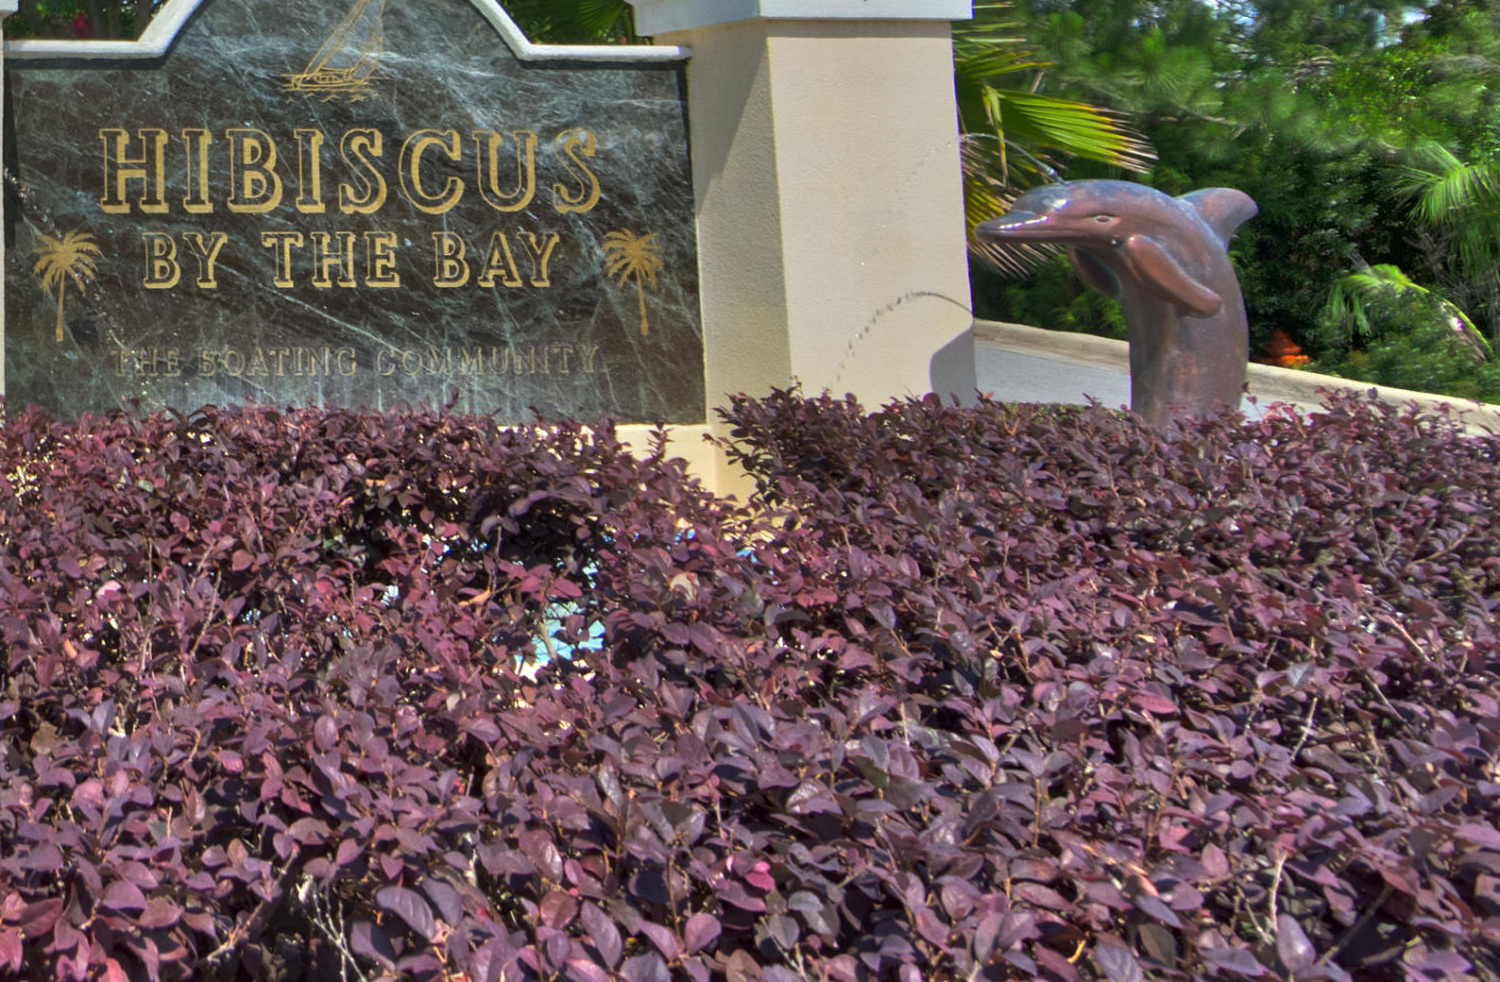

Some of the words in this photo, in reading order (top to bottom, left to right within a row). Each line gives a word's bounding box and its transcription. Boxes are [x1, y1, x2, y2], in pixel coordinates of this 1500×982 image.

[99, 127, 601, 215] HIBISCUS
[143, 230, 228, 289] BY
[262, 230, 400, 288] THE
[432, 229, 560, 289] BAY
[110, 346, 181, 377] THE
[197, 346, 357, 378] BOATING
[376, 343, 600, 376] COMMUNITY
